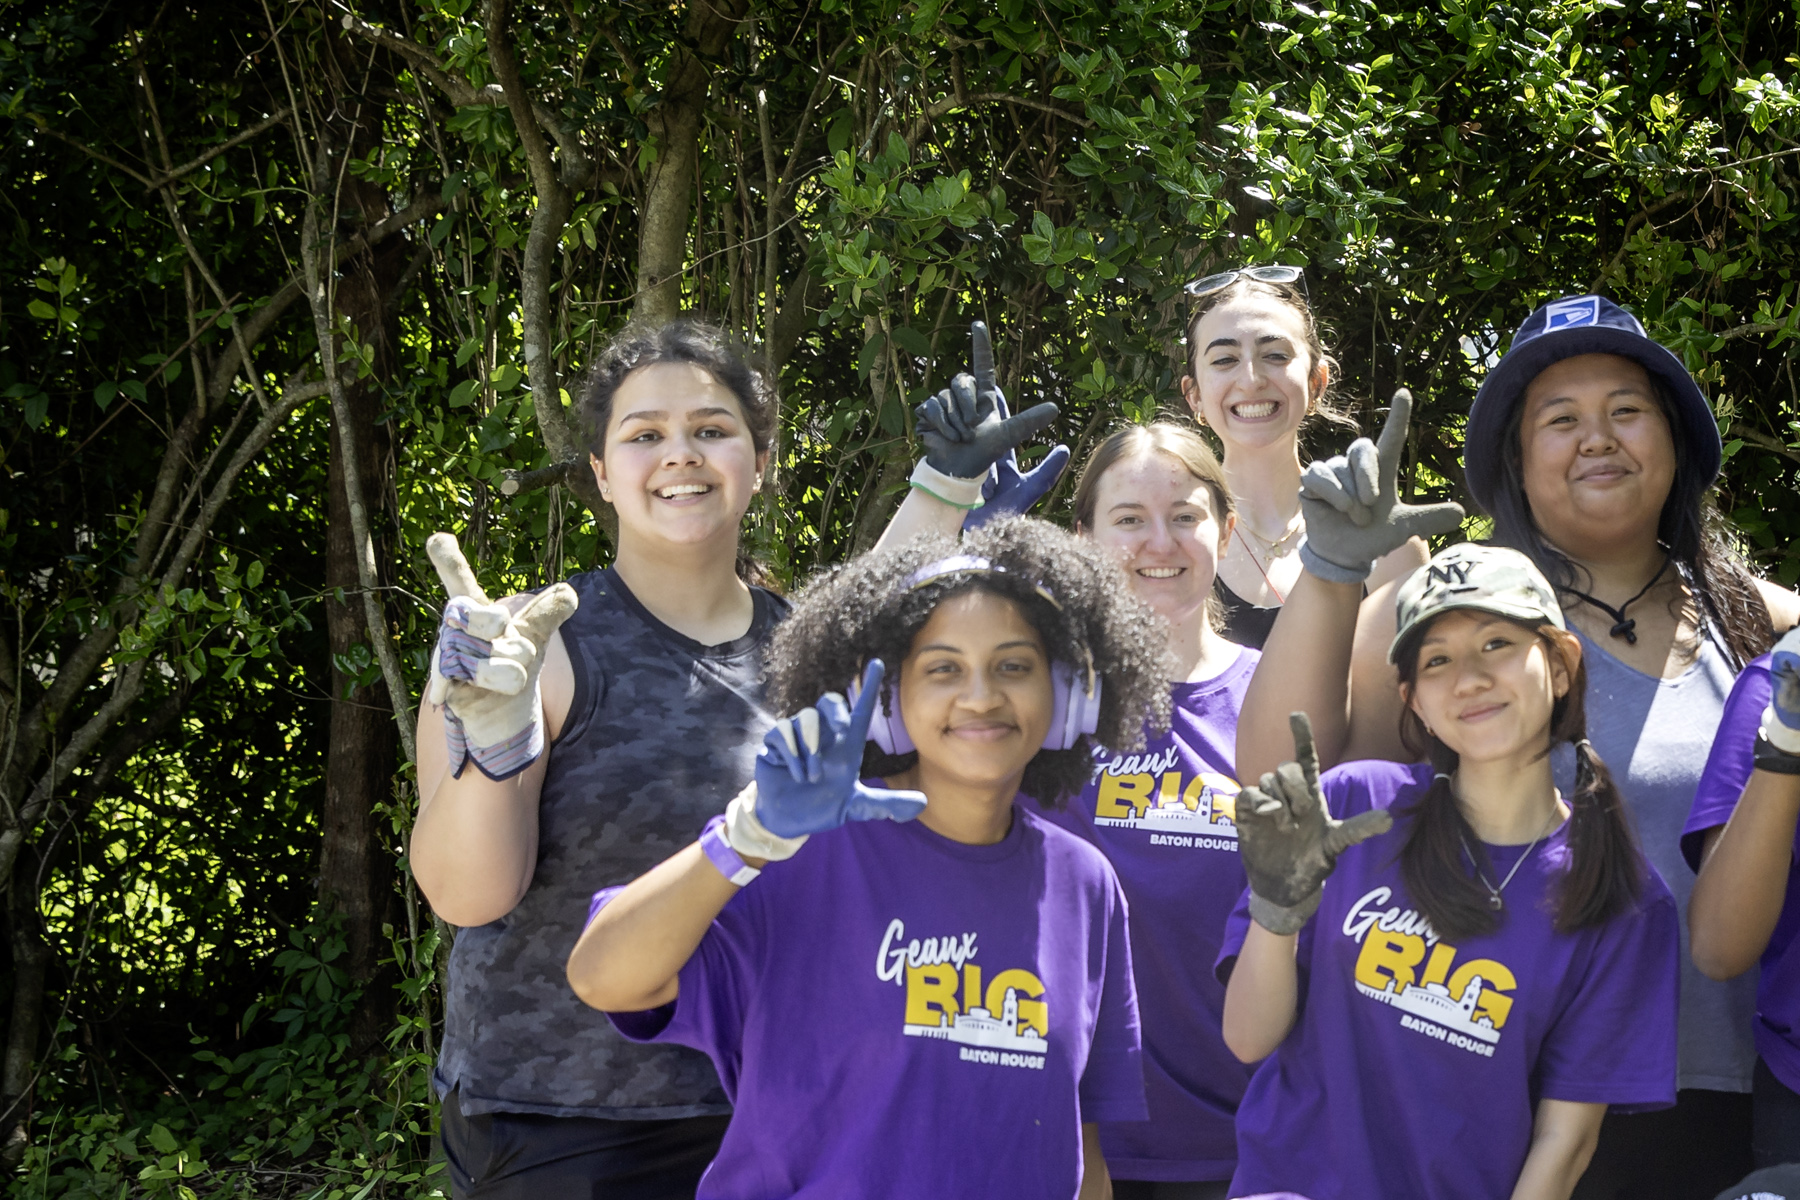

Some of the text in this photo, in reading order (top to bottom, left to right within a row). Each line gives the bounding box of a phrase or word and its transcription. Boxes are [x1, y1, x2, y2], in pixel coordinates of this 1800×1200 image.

[1095, 768, 1242, 824] BIG
[1150, 833, 1239, 852] BATON ROUGE
[876, 918, 978, 986] Geaux
[1355, 921, 1517, 1029] BIG
[904, 961, 1049, 1038] BIG
[959, 1047, 1045, 1070] BATON ROUGE
[1400, 1014, 1495, 1058] BATON ROUGE
